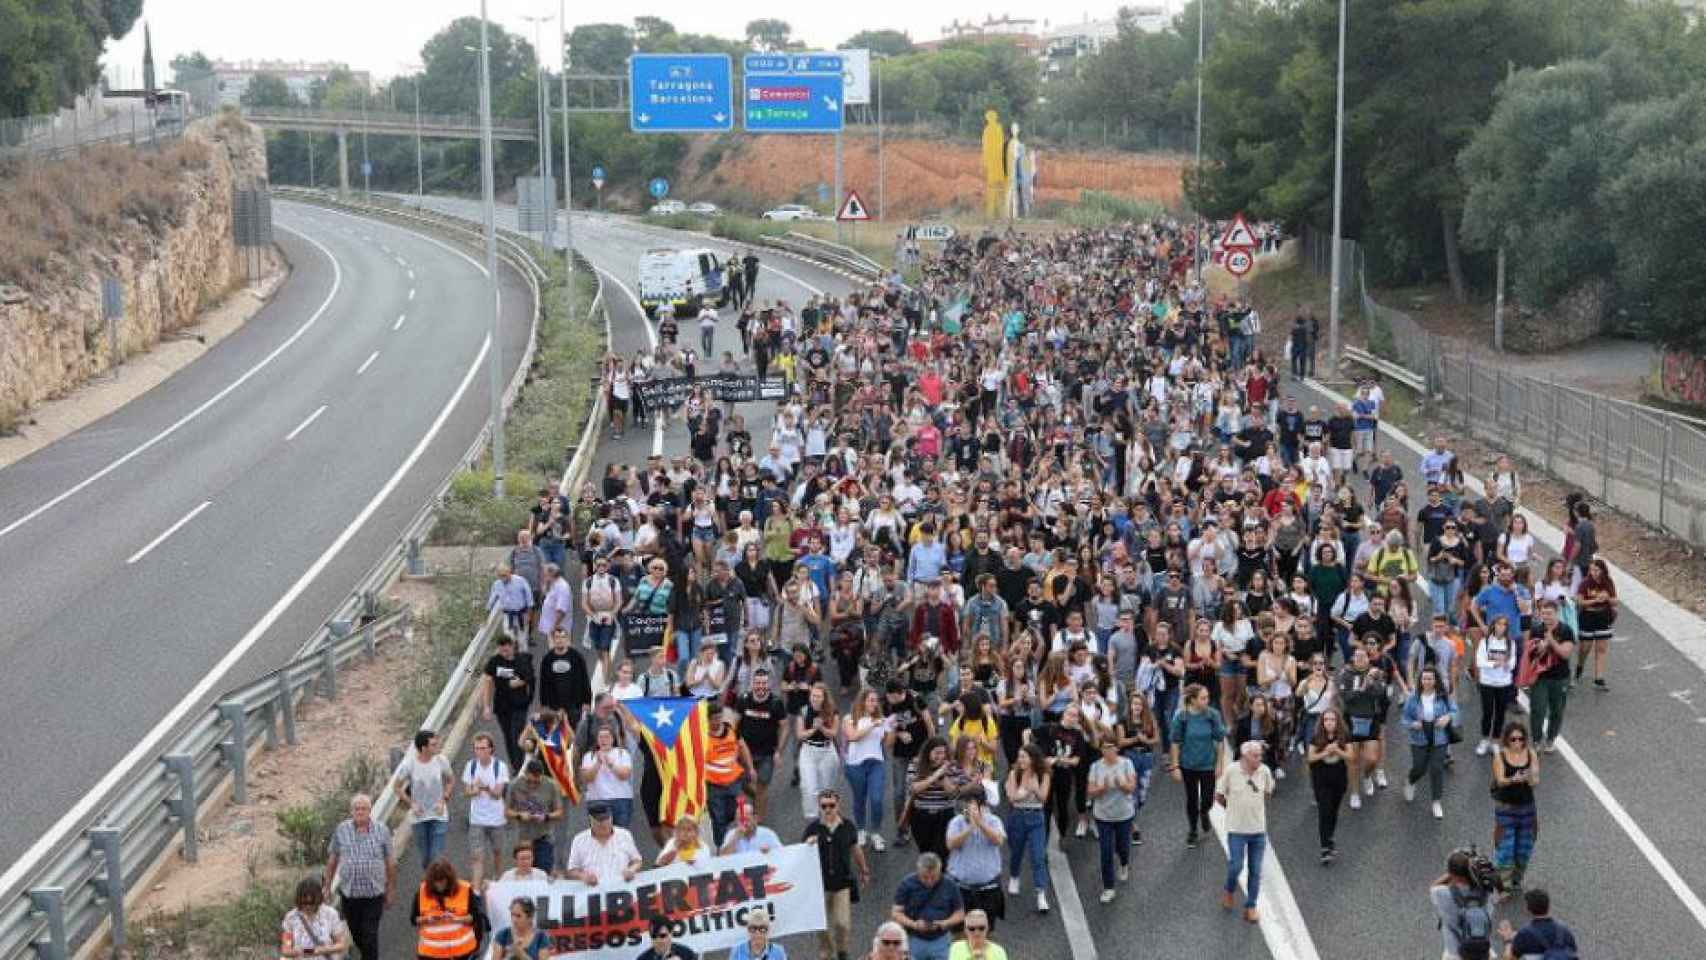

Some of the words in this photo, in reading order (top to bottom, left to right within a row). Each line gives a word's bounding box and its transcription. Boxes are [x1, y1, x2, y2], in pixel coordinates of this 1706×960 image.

[650, 79, 713, 91] Tarragona
[650, 94, 713, 104] Barcelona
[1233, 256, 1248, 265] 40
[535, 865, 769, 930] LLIBERTAT
[550, 928, 643, 952] RESOS
